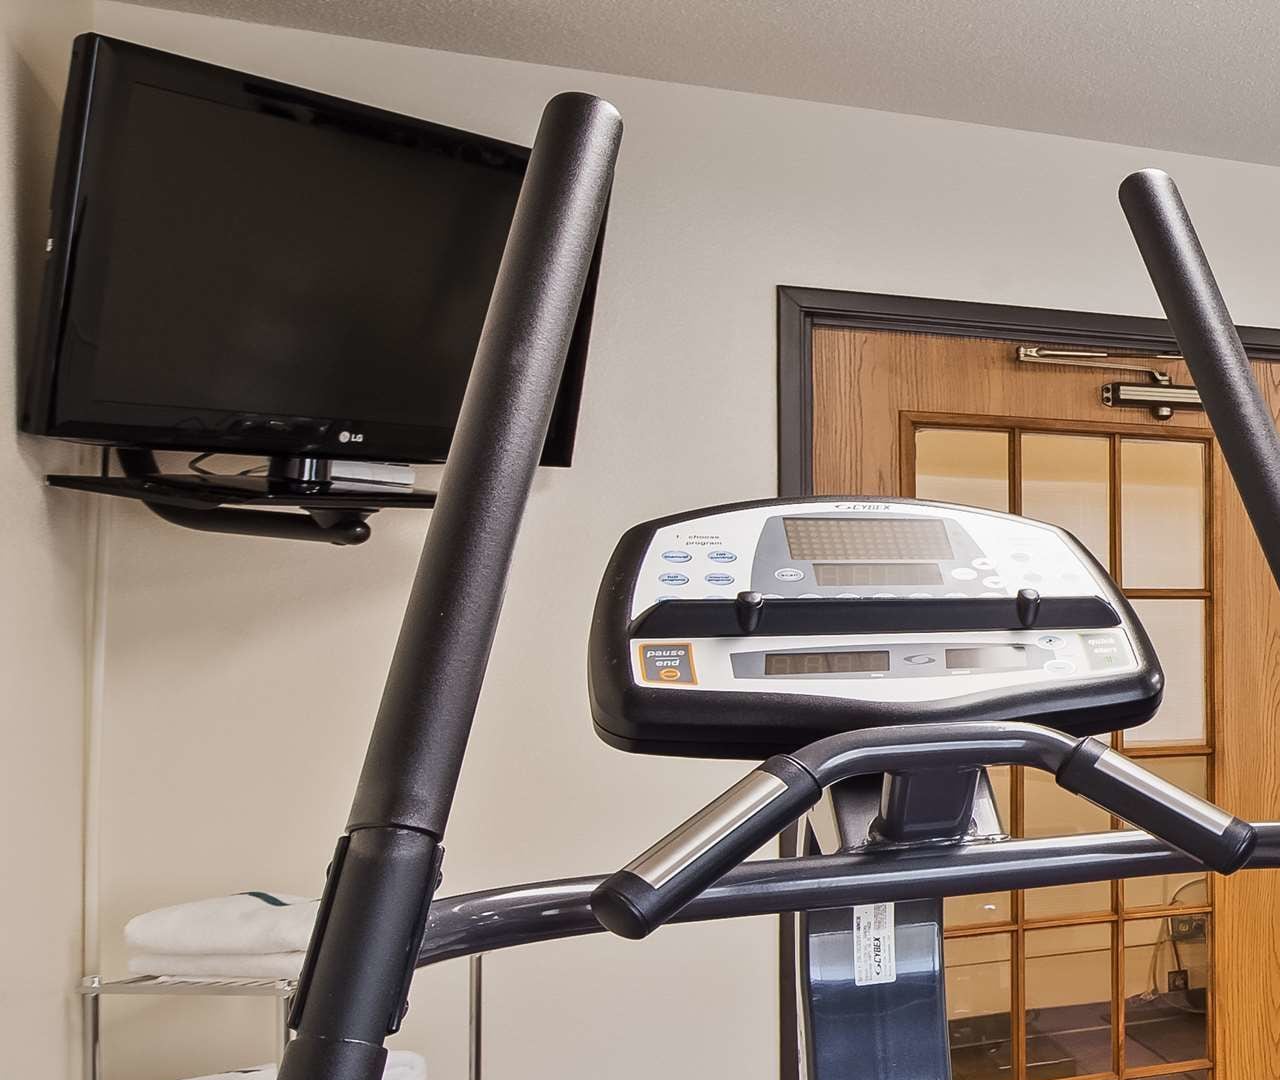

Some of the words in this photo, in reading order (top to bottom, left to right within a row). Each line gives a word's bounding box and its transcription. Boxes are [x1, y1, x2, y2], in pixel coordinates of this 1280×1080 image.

[350, 433, 364, 442] LG
[647, 649, 686, 658] pause
[655, 658, 681, 667] end
[872, 936, 882, 965] CYBEX
